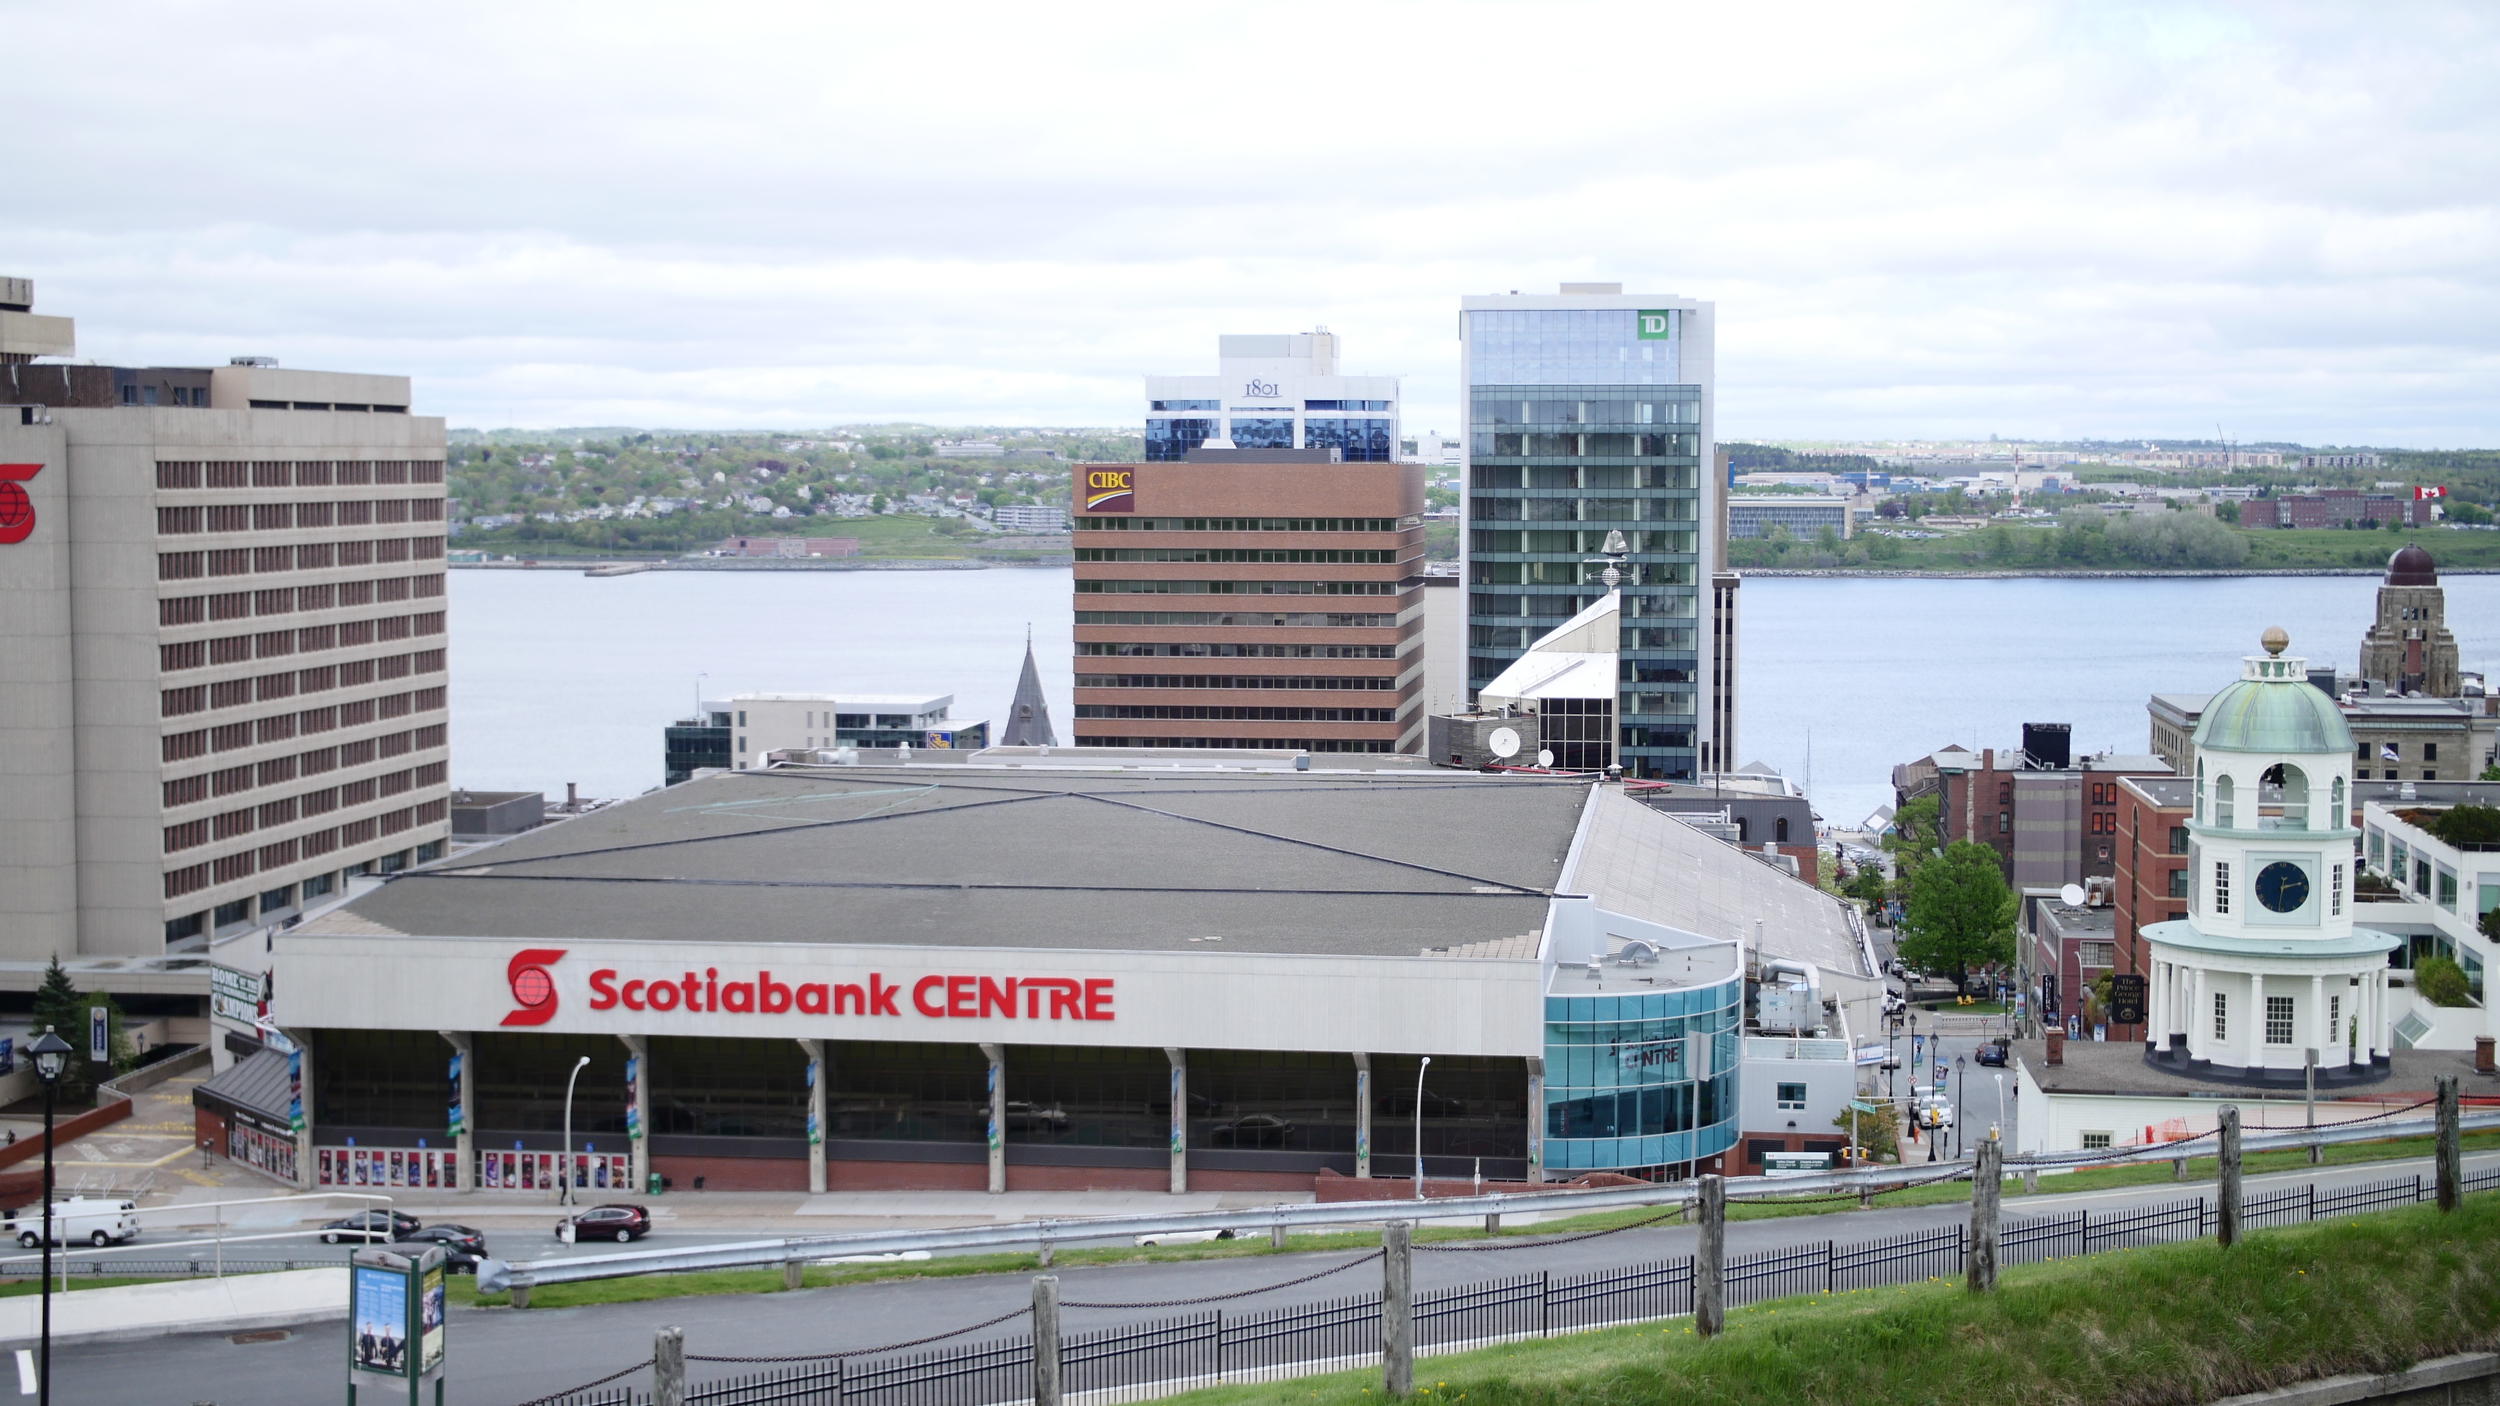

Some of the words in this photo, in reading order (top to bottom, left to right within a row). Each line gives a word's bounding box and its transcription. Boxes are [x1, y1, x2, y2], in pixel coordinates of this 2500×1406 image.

[1640, 315, 1666, 333] TD
[1245, 378, 1279, 396] 1801
[1088, 471, 1131, 488] CIBC
[212, 967, 239, 988] HOME
[588, 967, 901, 1016] Scotiabank
[913, 974, 1115, 1021] CENTRE
